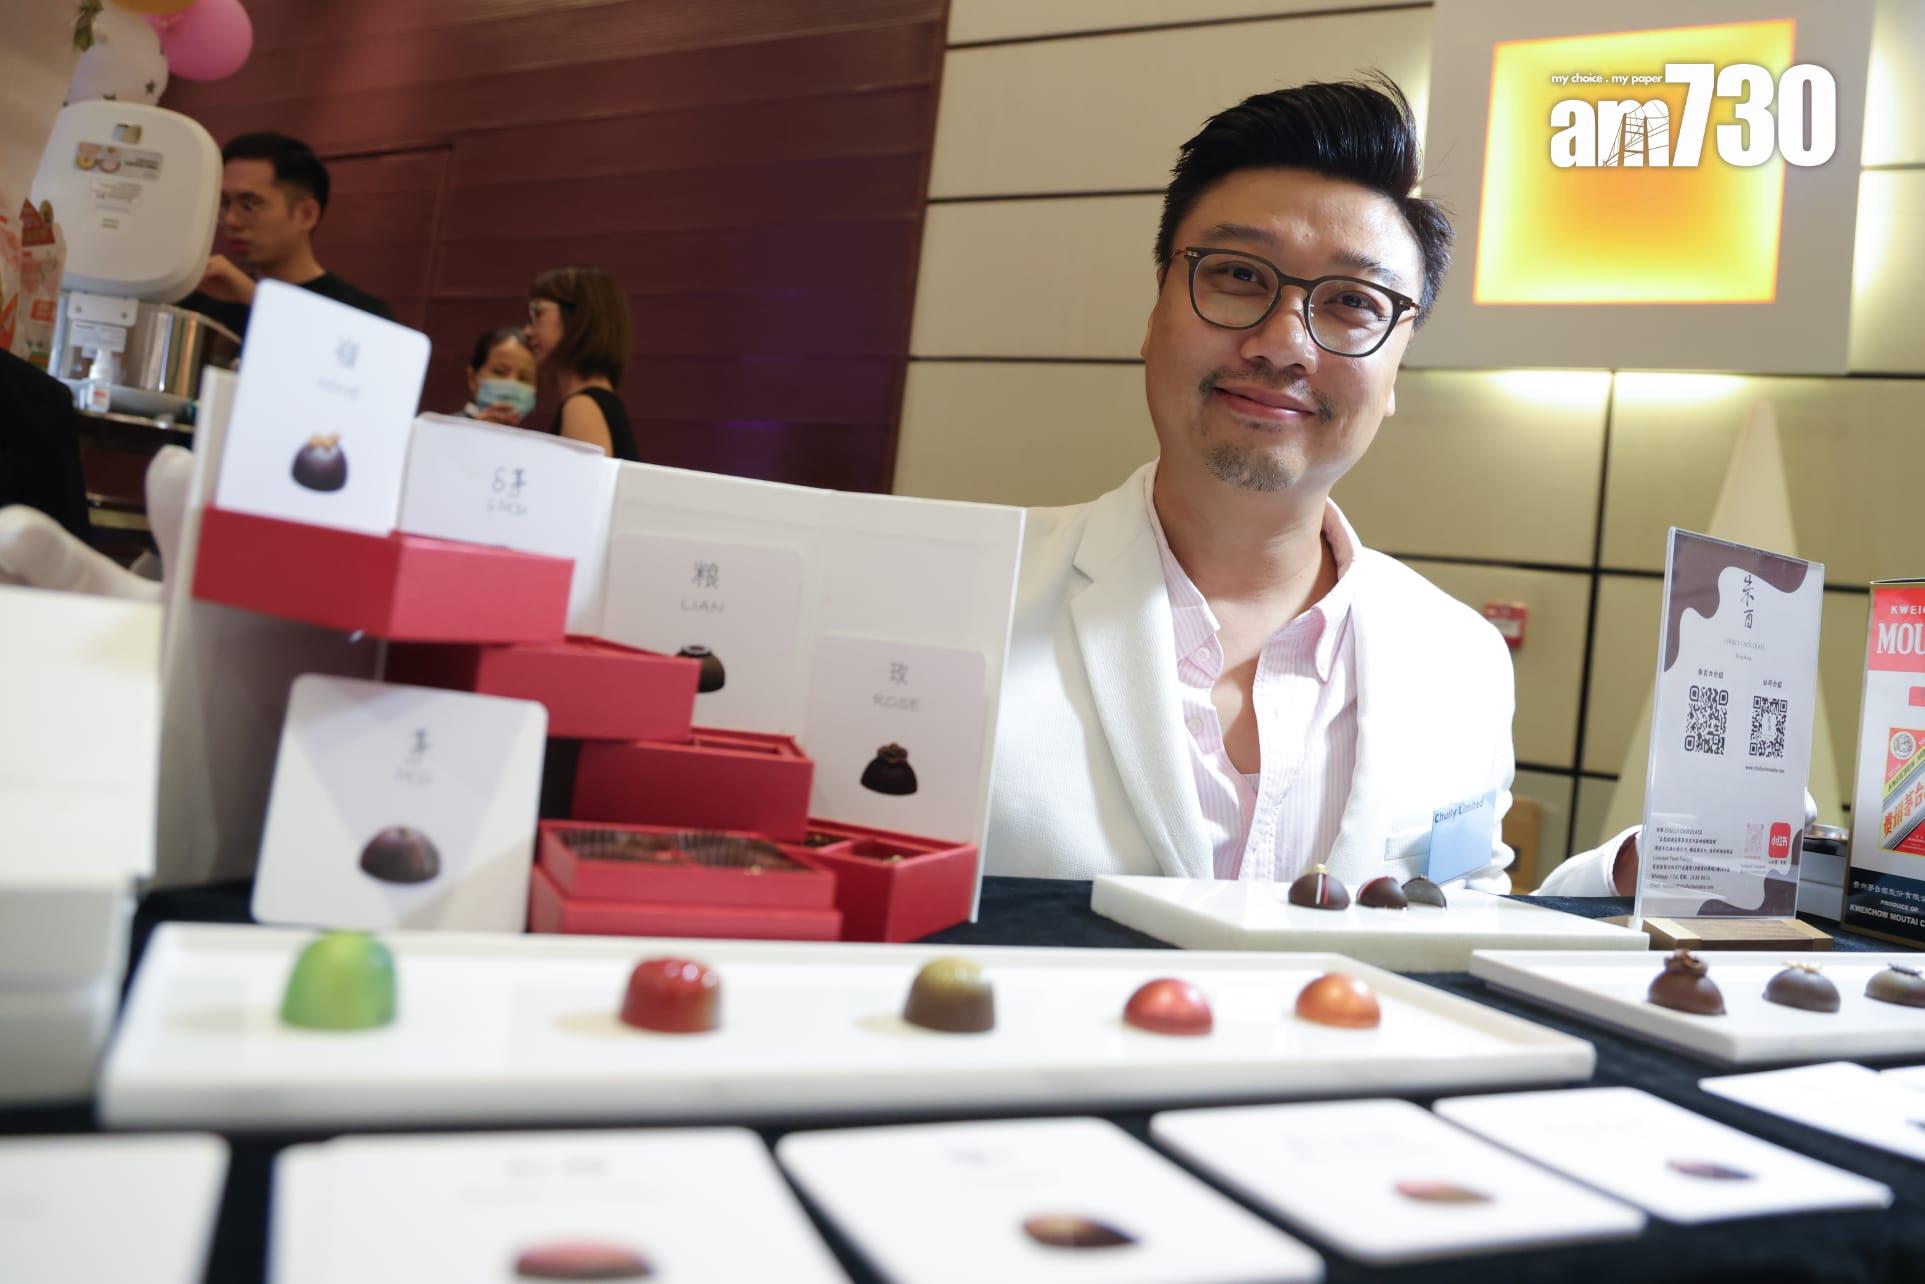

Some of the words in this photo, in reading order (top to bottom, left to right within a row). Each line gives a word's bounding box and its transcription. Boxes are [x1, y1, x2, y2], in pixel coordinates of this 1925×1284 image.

[1890, 605, 1925, 615] KWEI
[1459, 797, 1484, 815] Limited
[1849, 904, 1889, 919] KWEICHOW
[1889, 912, 1918, 925] MOUTAI
